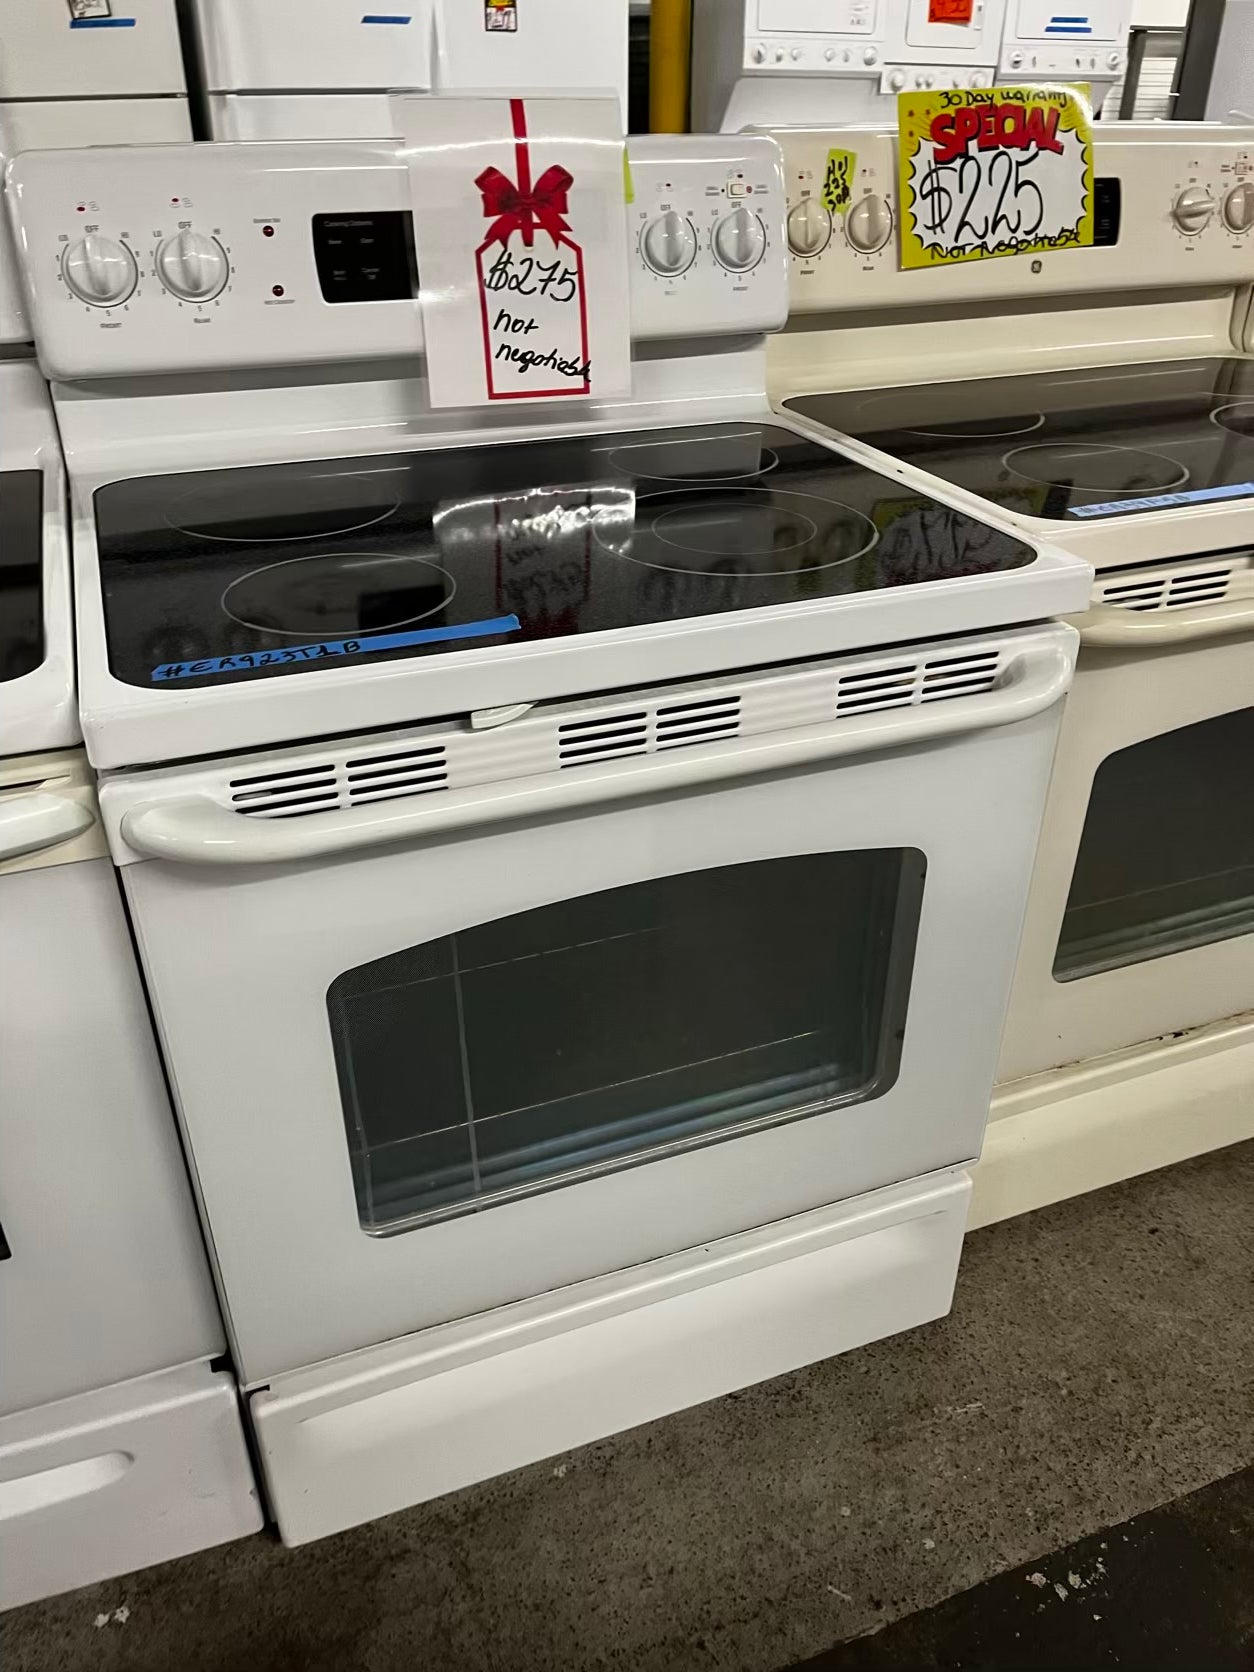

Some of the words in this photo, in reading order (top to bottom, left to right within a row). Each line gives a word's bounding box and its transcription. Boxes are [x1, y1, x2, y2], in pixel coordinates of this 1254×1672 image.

[939, 91, 962, 109] 30
[965, 91, 995, 112] Day
[930, 103, 1065, 165] SPECIAL
[919, 149, 1044, 244] $225
[484, 247, 578, 302] $275
[493, 308, 539, 335] not
